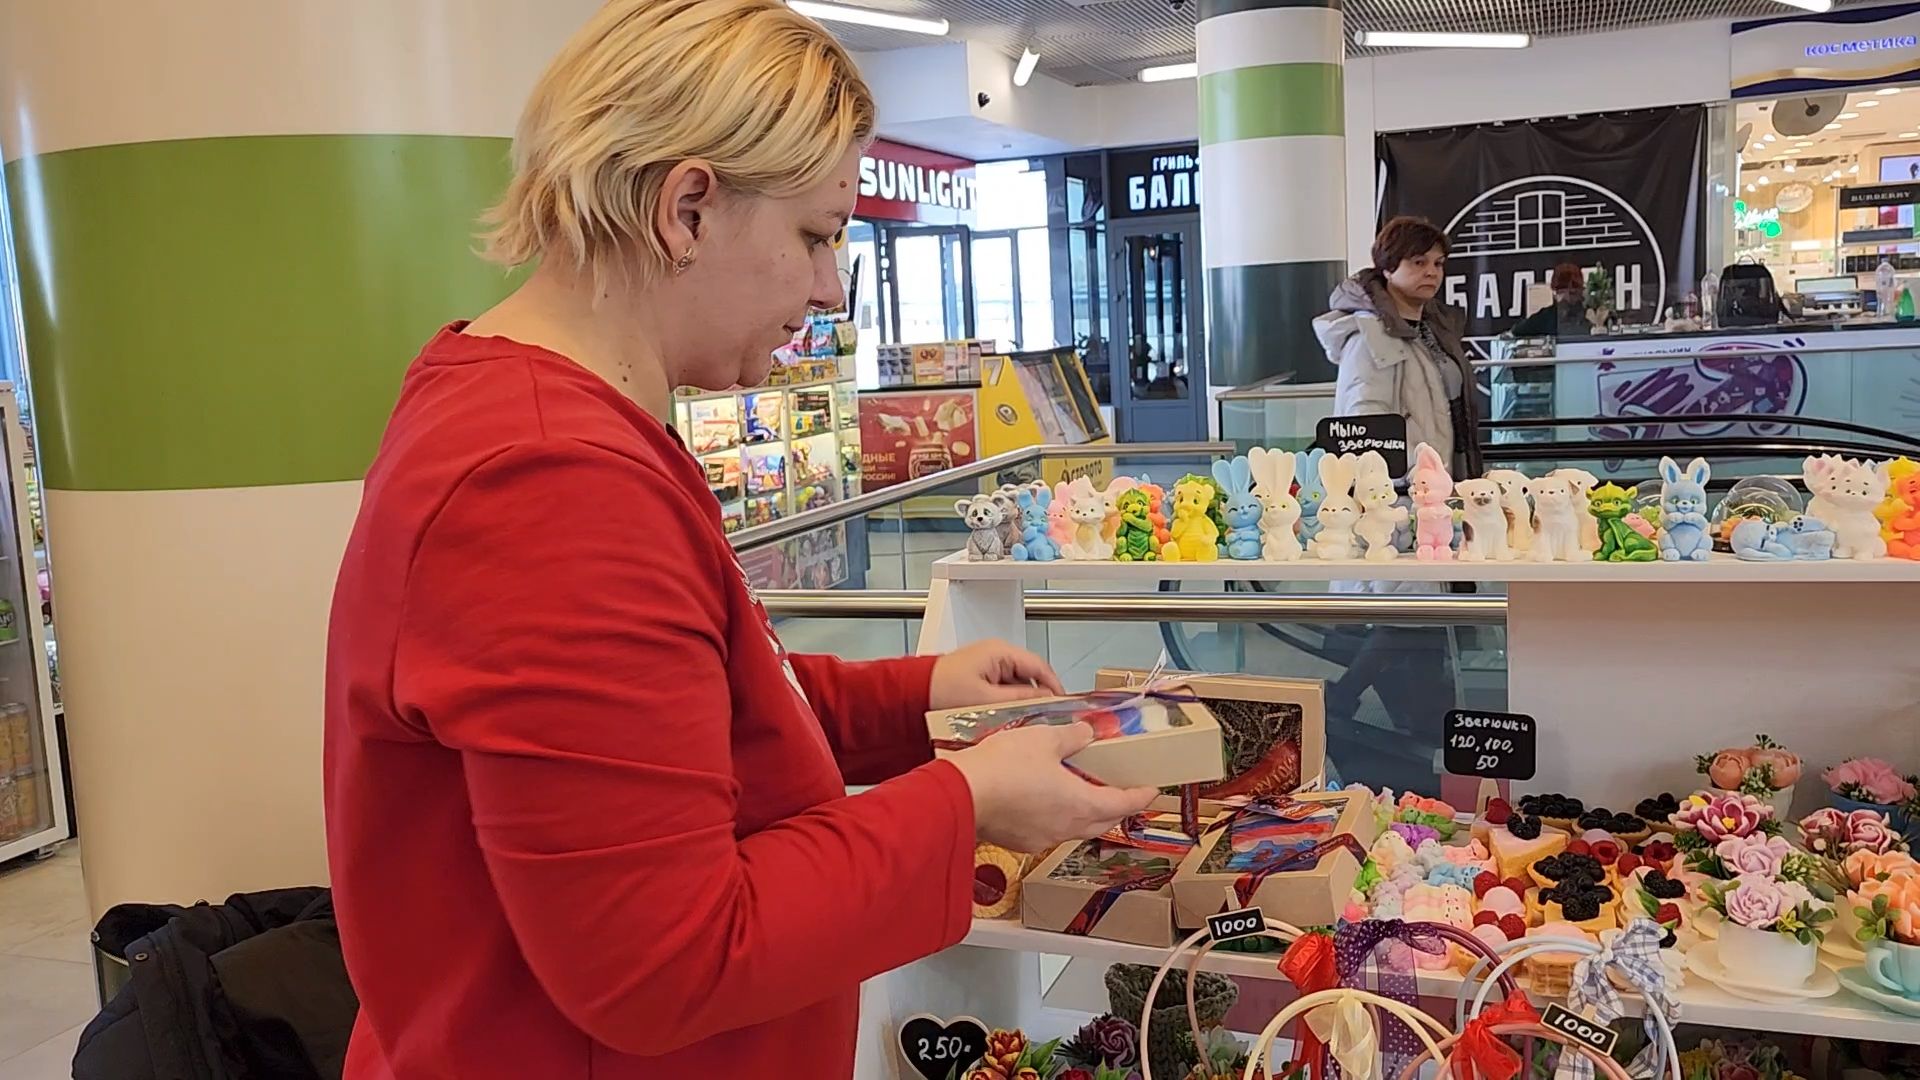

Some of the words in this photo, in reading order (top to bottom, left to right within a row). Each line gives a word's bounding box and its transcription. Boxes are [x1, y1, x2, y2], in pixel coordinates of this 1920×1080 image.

[860, 156, 978, 212] SUNLIGHT
[1850, 191, 1911, 202] BURBERRY
[1445, 263, 1642, 319] БАЛН
[1329, 421, 1367, 438] Мыло
[1453, 713, 1529, 731] Зверюшки
[1449, 734, 1480, 752] 120,
[1484, 737, 1514, 754] 100,
[1475, 755, 1499, 770] 50
[1215, 917, 1257, 936] 1000
[1554, 1013, 1607, 1045] 1000
